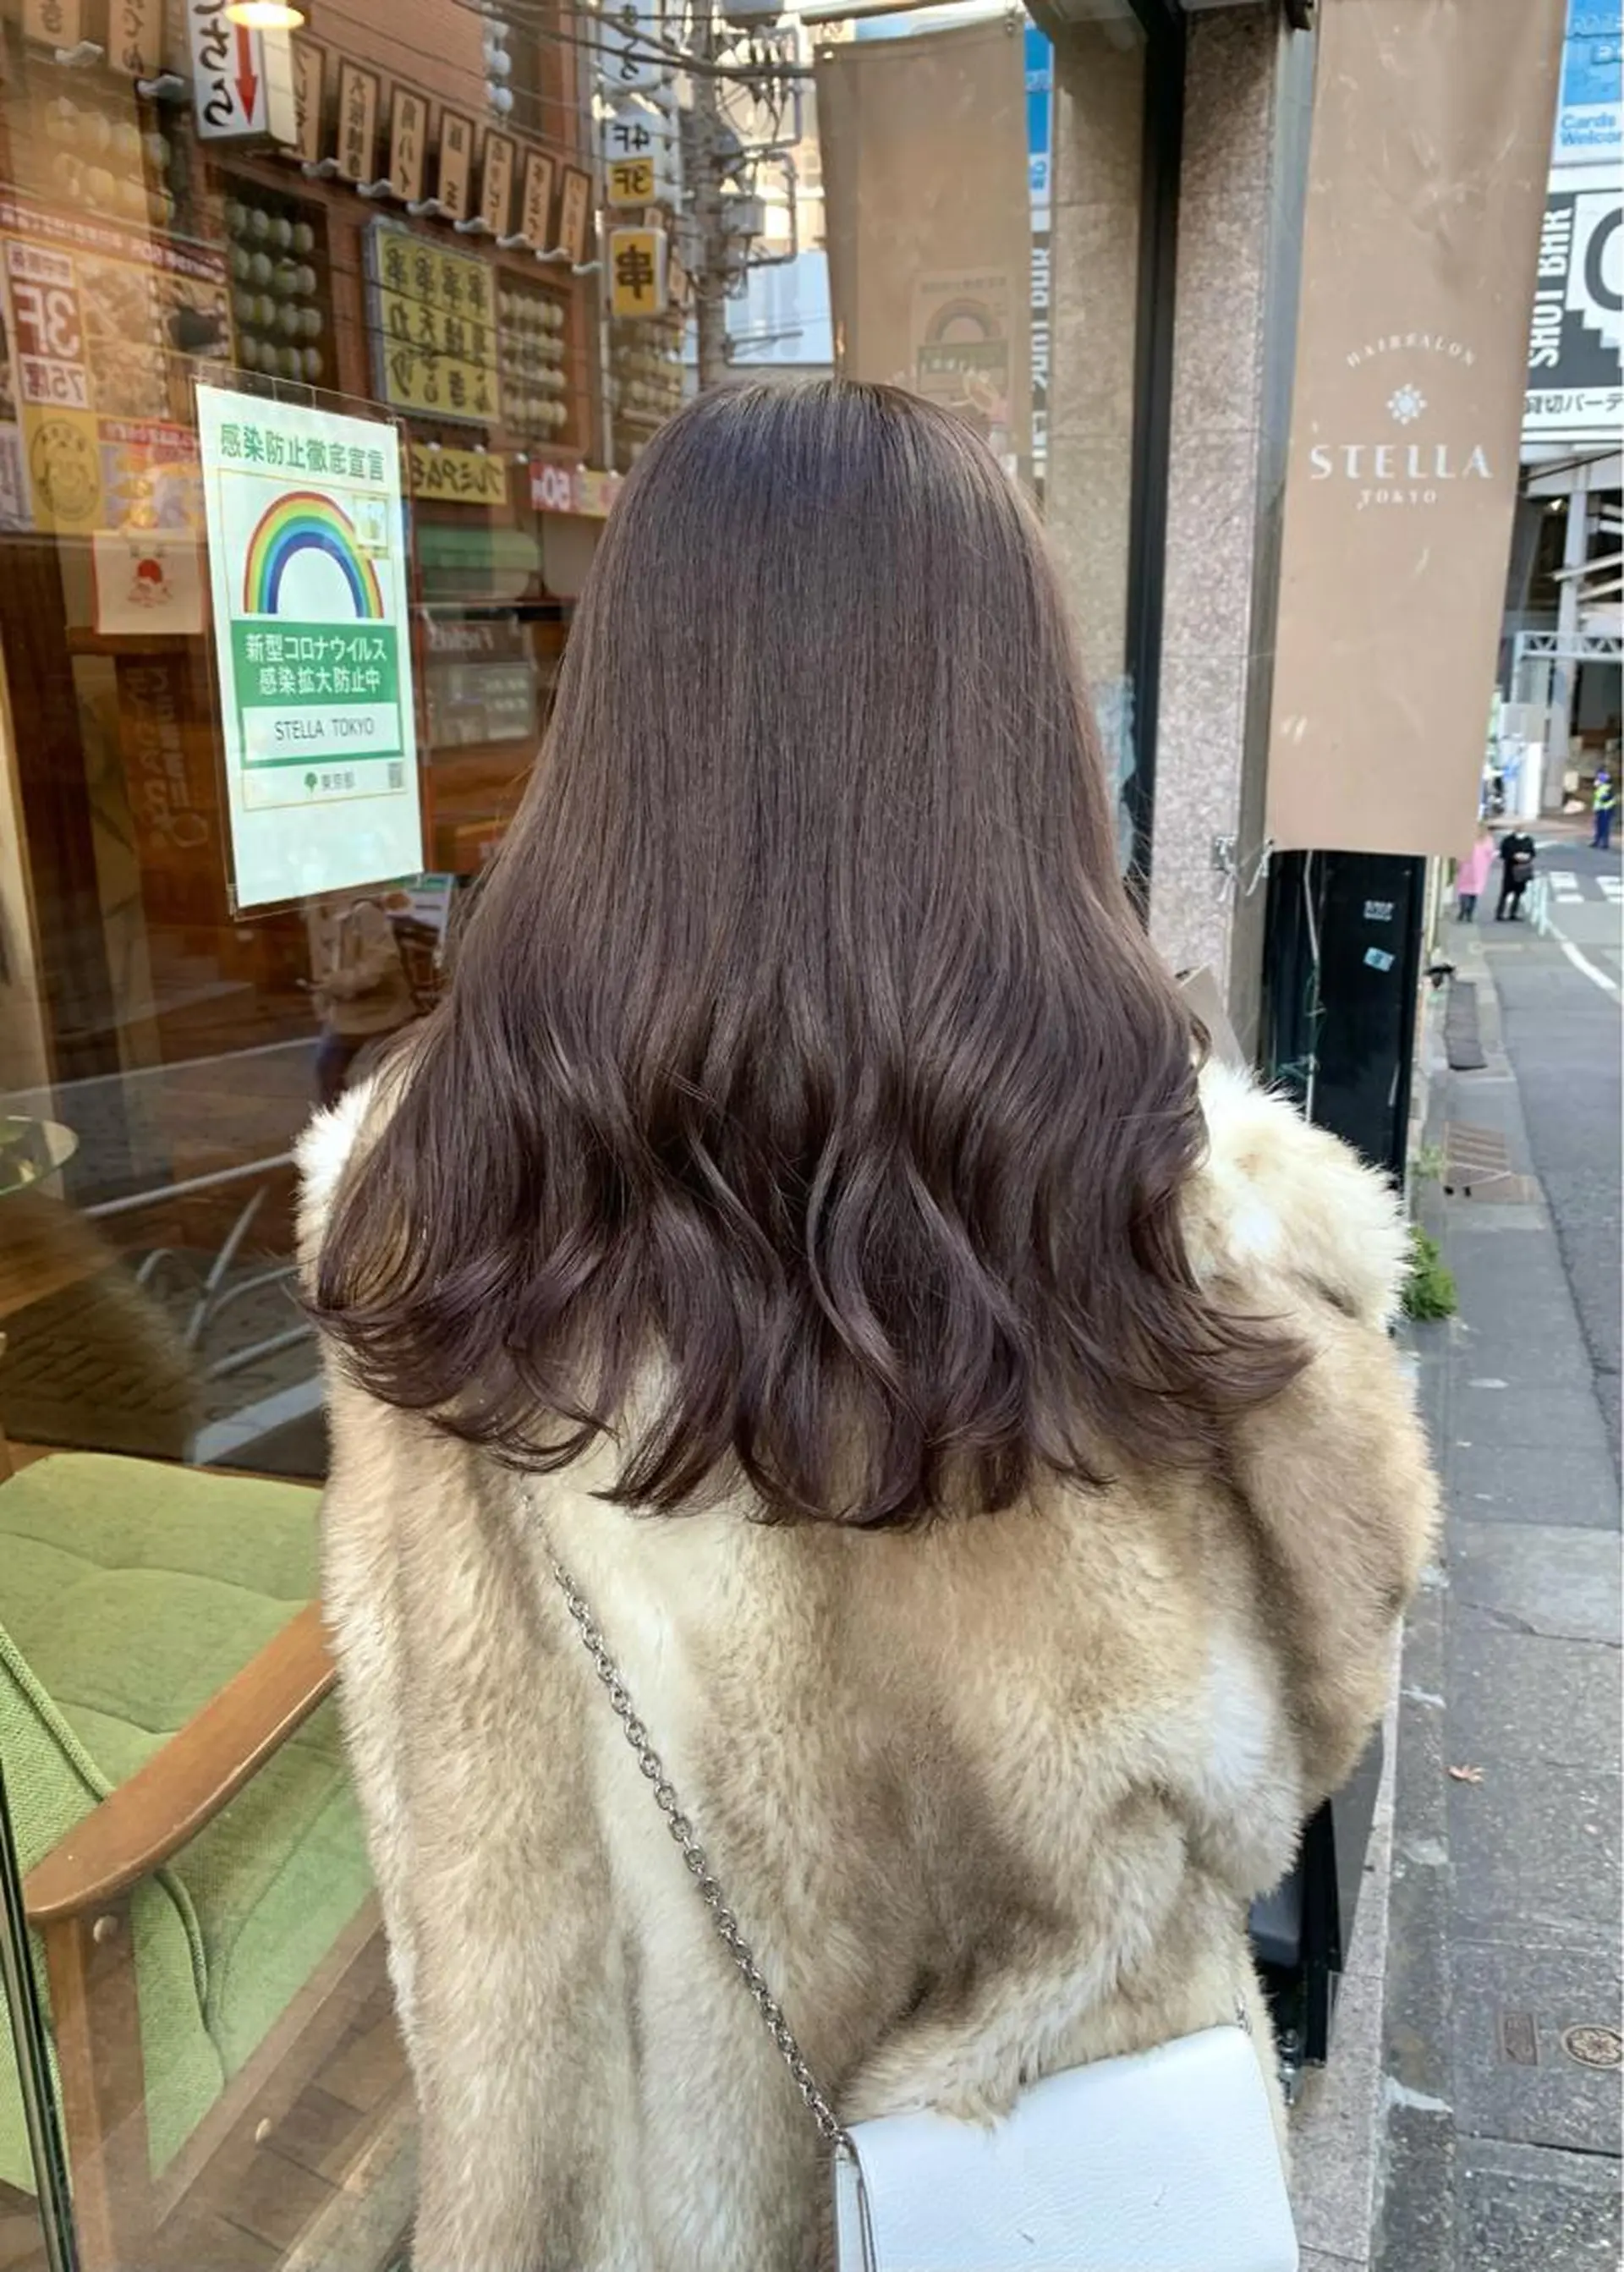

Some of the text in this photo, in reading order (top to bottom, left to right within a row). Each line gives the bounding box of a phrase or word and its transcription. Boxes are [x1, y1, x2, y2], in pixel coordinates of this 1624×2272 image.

[1561, 113, 1615, 128] Cards
[221, 424, 385, 481] 感染防止徹底宣言
[1310, 444, 1494, 480] STELLA
[1360, 490, 1438, 504] TOKYO
[245, 634, 387, 662] 新型コロナウイルス
[259, 667, 381, 696] 感染拡大防止中
[274, 717, 375, 741] STELLA TOKYO
